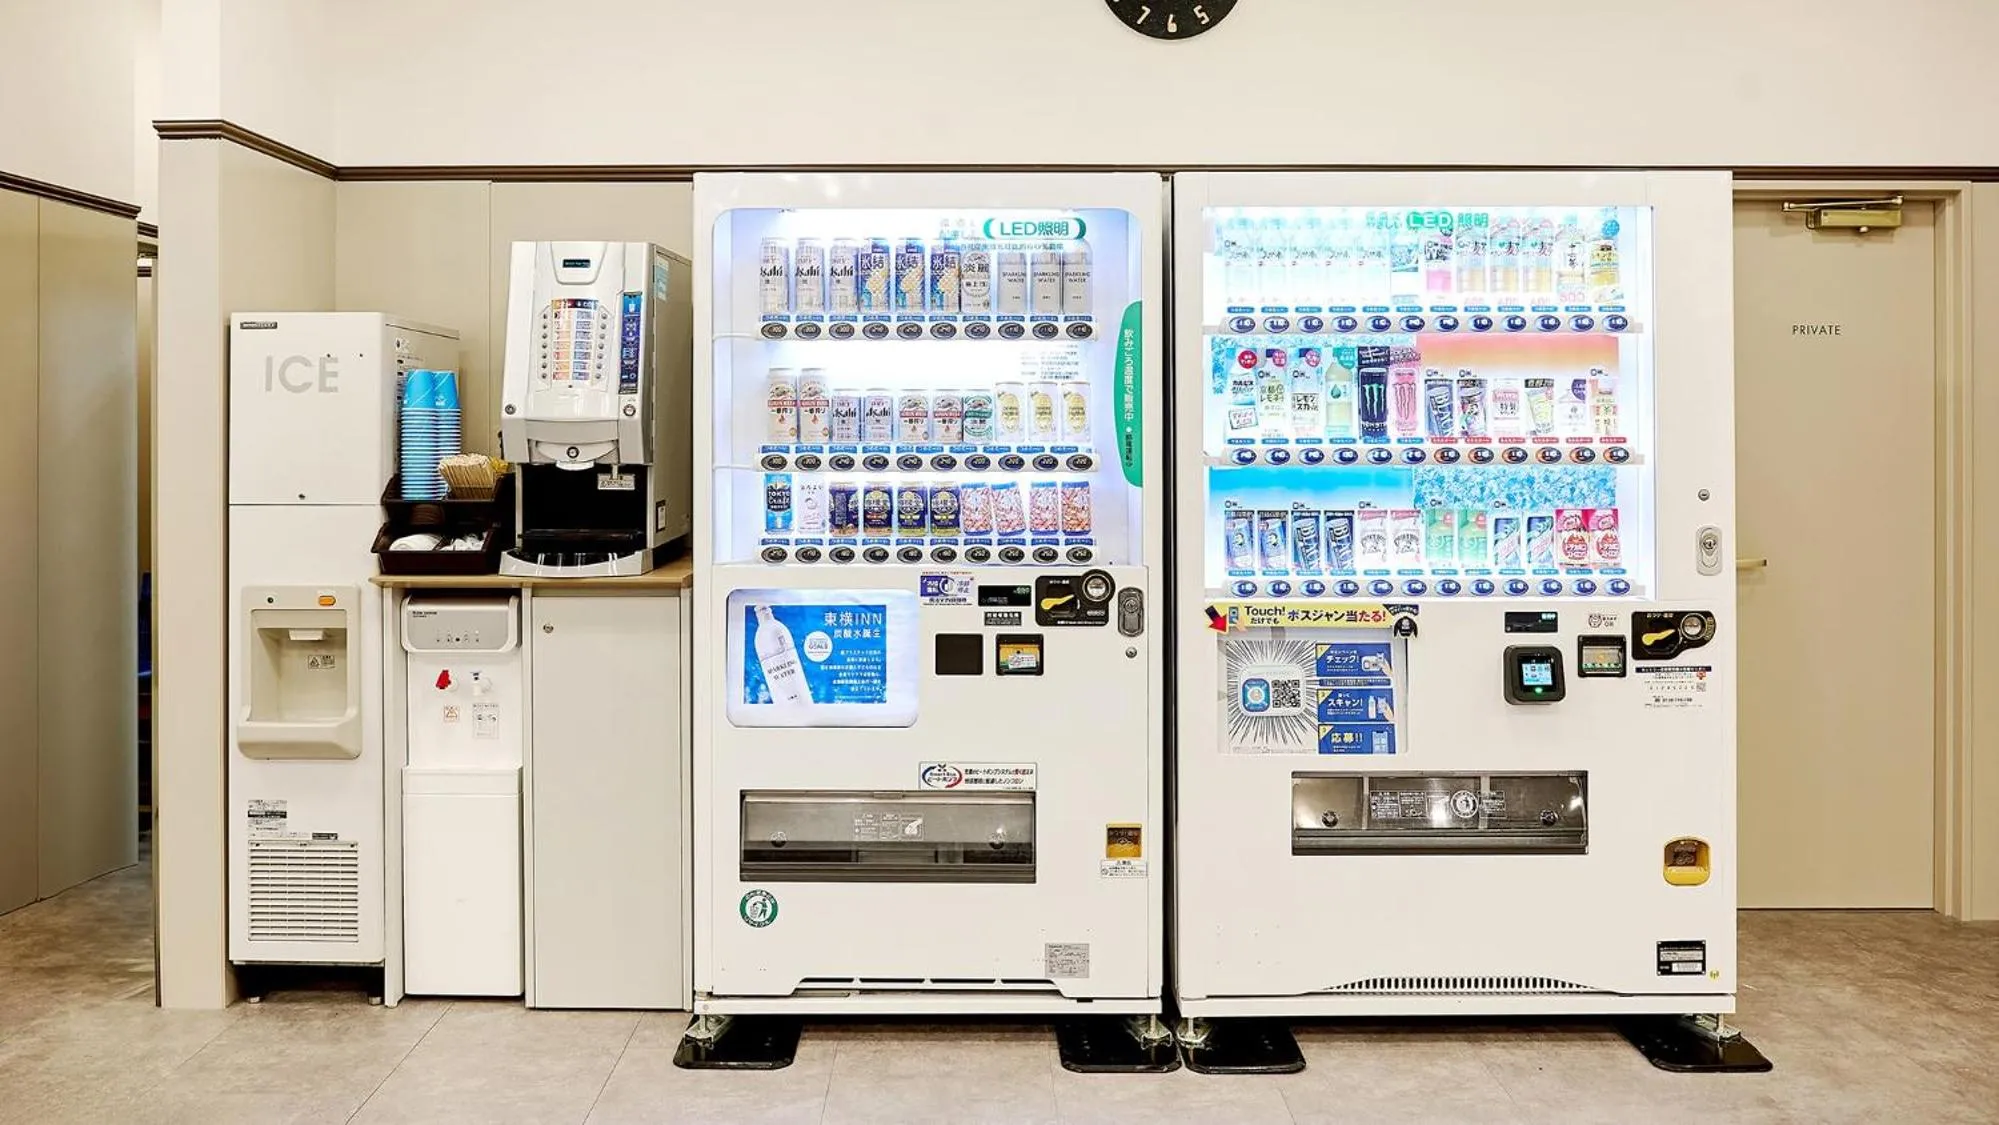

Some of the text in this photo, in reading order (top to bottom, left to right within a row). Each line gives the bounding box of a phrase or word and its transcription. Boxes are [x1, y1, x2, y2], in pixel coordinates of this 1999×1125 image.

[1136, 5, 1151, 24] 7
[1193, 5, 1210, 25] 5
[1167, 14, 1177, 33] 6
[1000, 221, 1069, 236] LED照明
[1792, 325, 1841, 336] PRIVATE
[265, 355, 339, 393] ICE
[865, 407, 891, 417] Asahi
[1244, 606, 1286, 616] Touch!
[824, 611, 882, 626] 東横INN
[834, 628, 881, 639] 炭酸水誕生
[1326, 655, 1360, 664] チェック!
[1328, 698, 1363, 707] スキャン!
